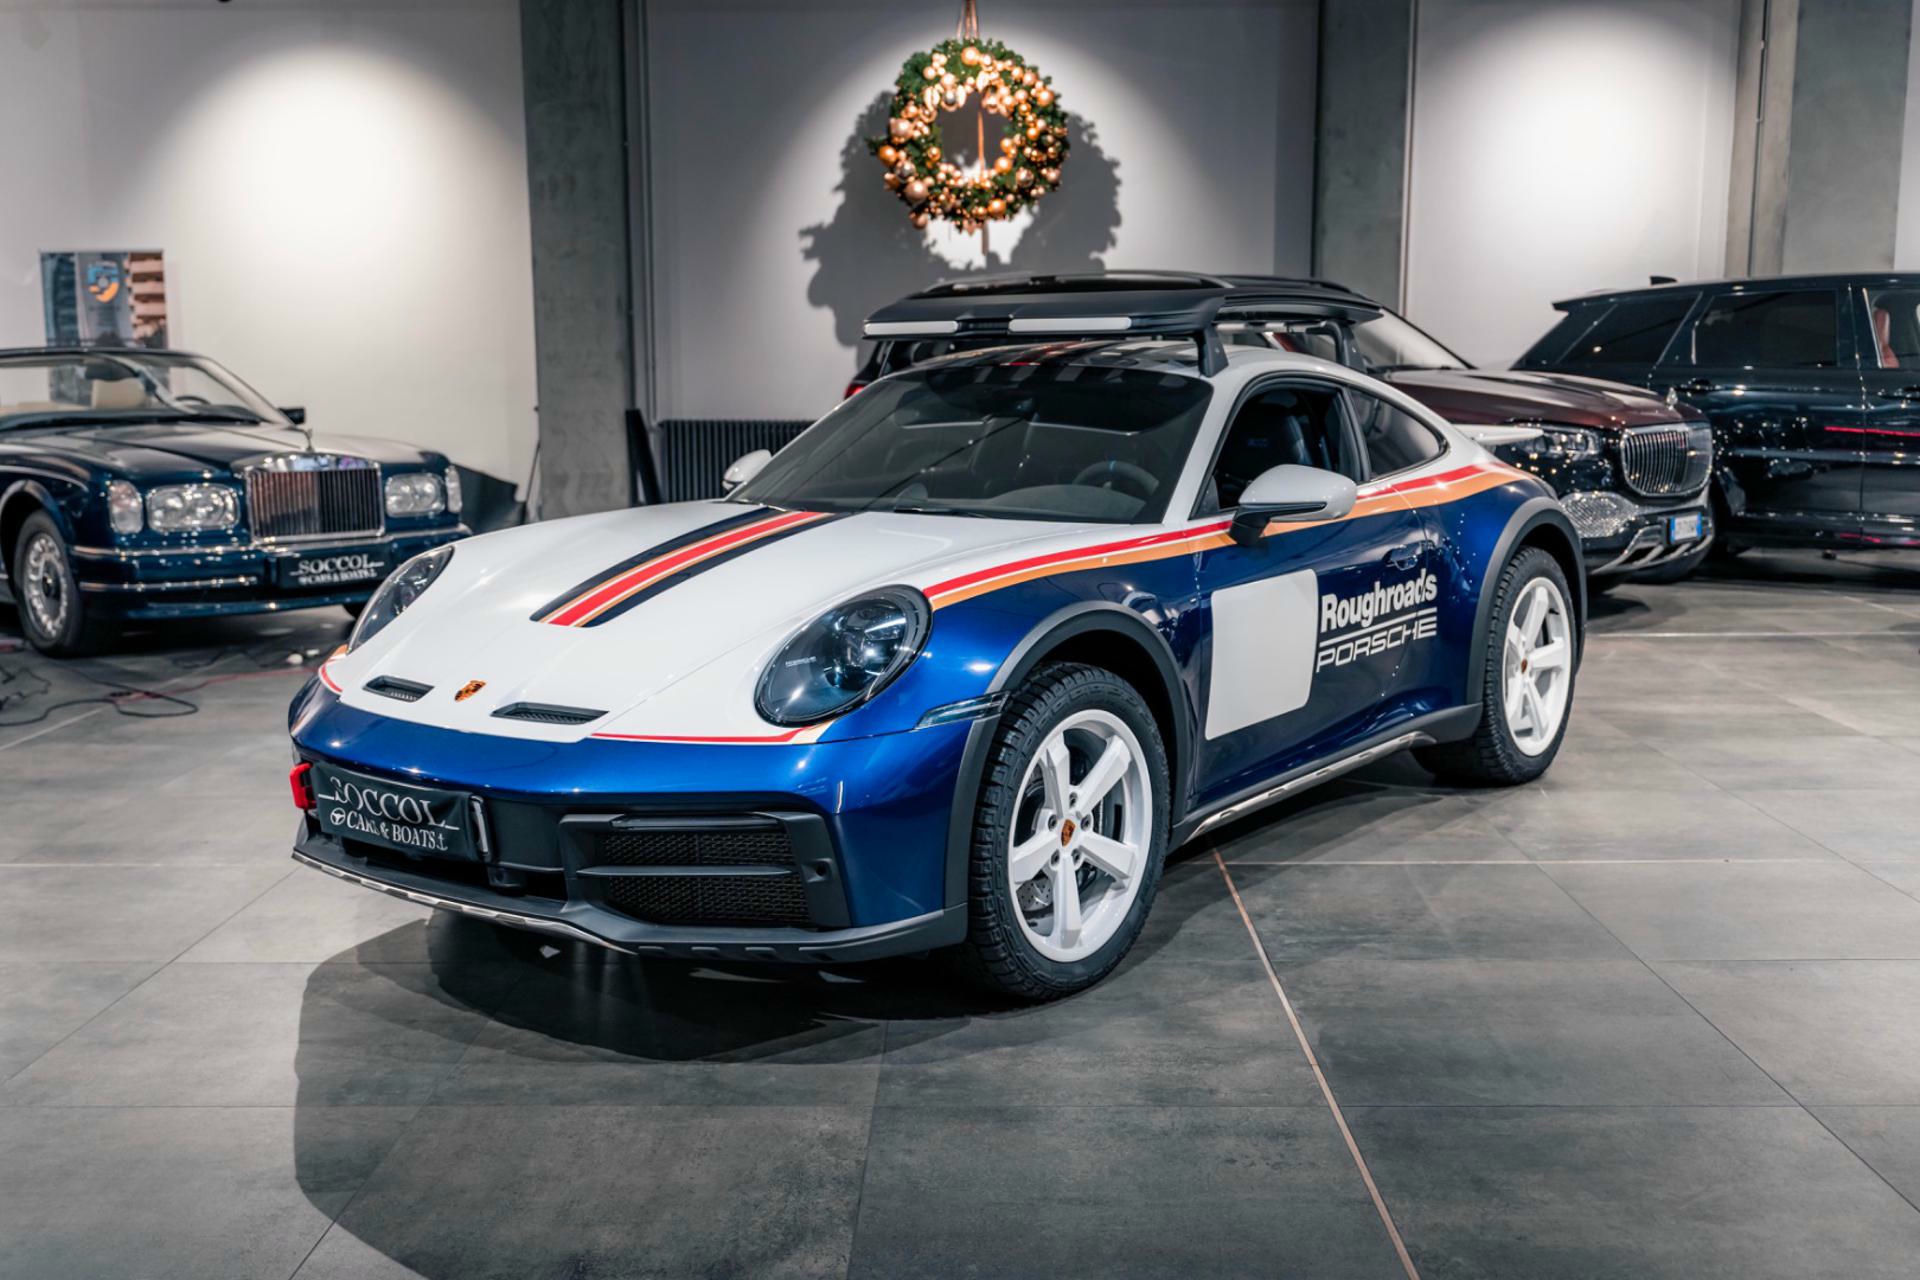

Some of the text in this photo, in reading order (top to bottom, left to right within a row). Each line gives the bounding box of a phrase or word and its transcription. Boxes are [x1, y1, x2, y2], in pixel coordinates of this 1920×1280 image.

[299, 554, 370, 575] SOCCOL
[1321, 568, 1437, 633] Roughroads
[1315, 616, 1437, 673] PORSCHE
[330, 776, 446, 827] SOCCOL
[392, 823, 436, 849] BOATS
